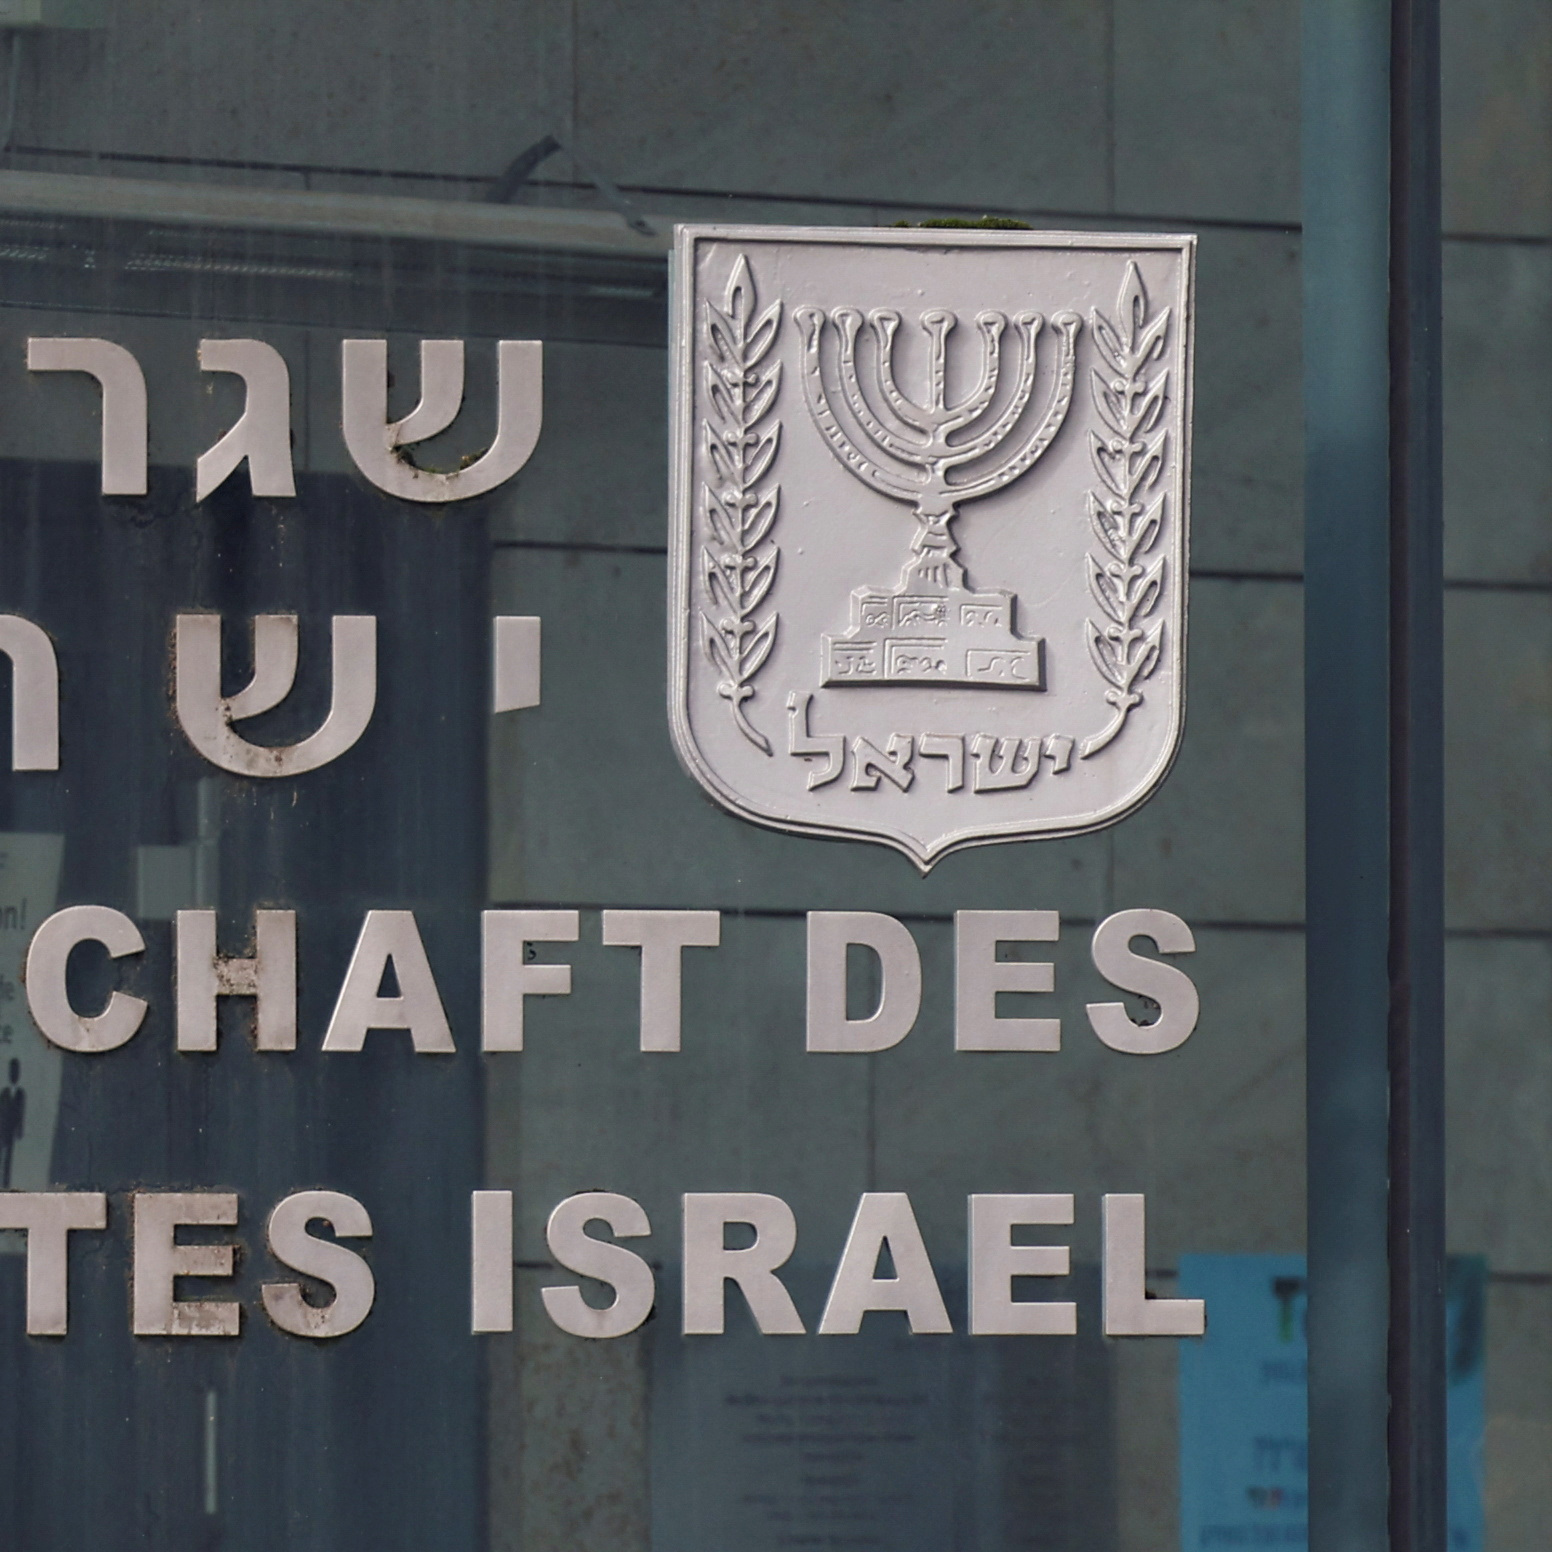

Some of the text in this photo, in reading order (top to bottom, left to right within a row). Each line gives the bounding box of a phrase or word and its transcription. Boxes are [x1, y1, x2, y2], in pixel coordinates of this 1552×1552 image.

[786, 700, 1075, 794] ישראל
[805, 908, 1200, 1055] DES
[471, 1190, 1206, 1338] ISRAEL
